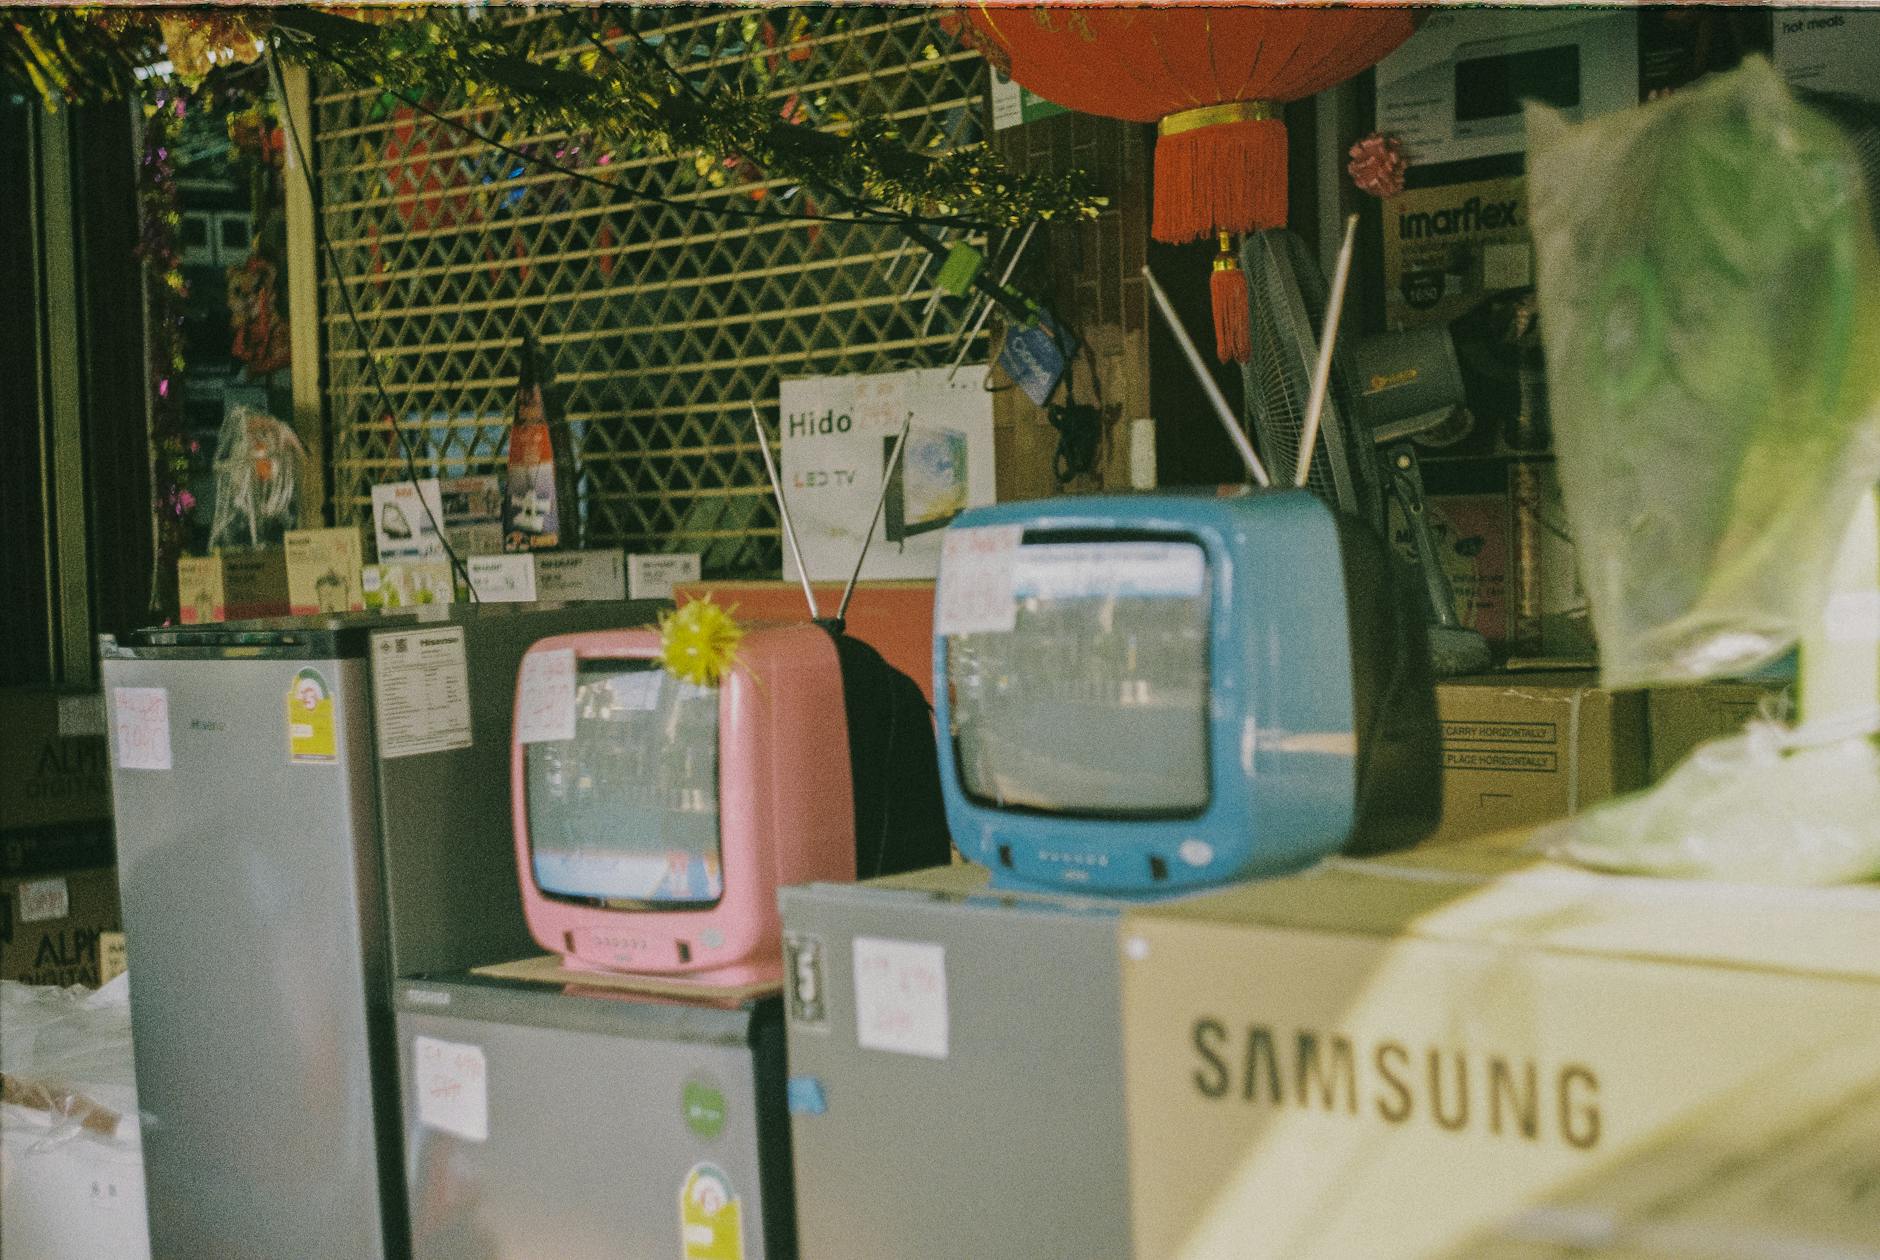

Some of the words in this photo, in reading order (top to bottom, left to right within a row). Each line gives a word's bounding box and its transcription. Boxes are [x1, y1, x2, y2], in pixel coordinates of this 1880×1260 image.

[1783, 21, 1803, 34] hot
[1807, 15, 1845, 30] meals
[1399, 196, 1517, 240] imarflex
[789, 411, 853, 438] Hido
[794, 471, 829, 488] LED
[834, 470, 857, 485] TV
[1446, 726, 1476, 736] CARRY
[1479, 727, 1547, 738] HORIZONTALLY
[1447, 754, 1477, 765] PLACE
[1191, 1016, 1602, 1149] SAMSUNG
